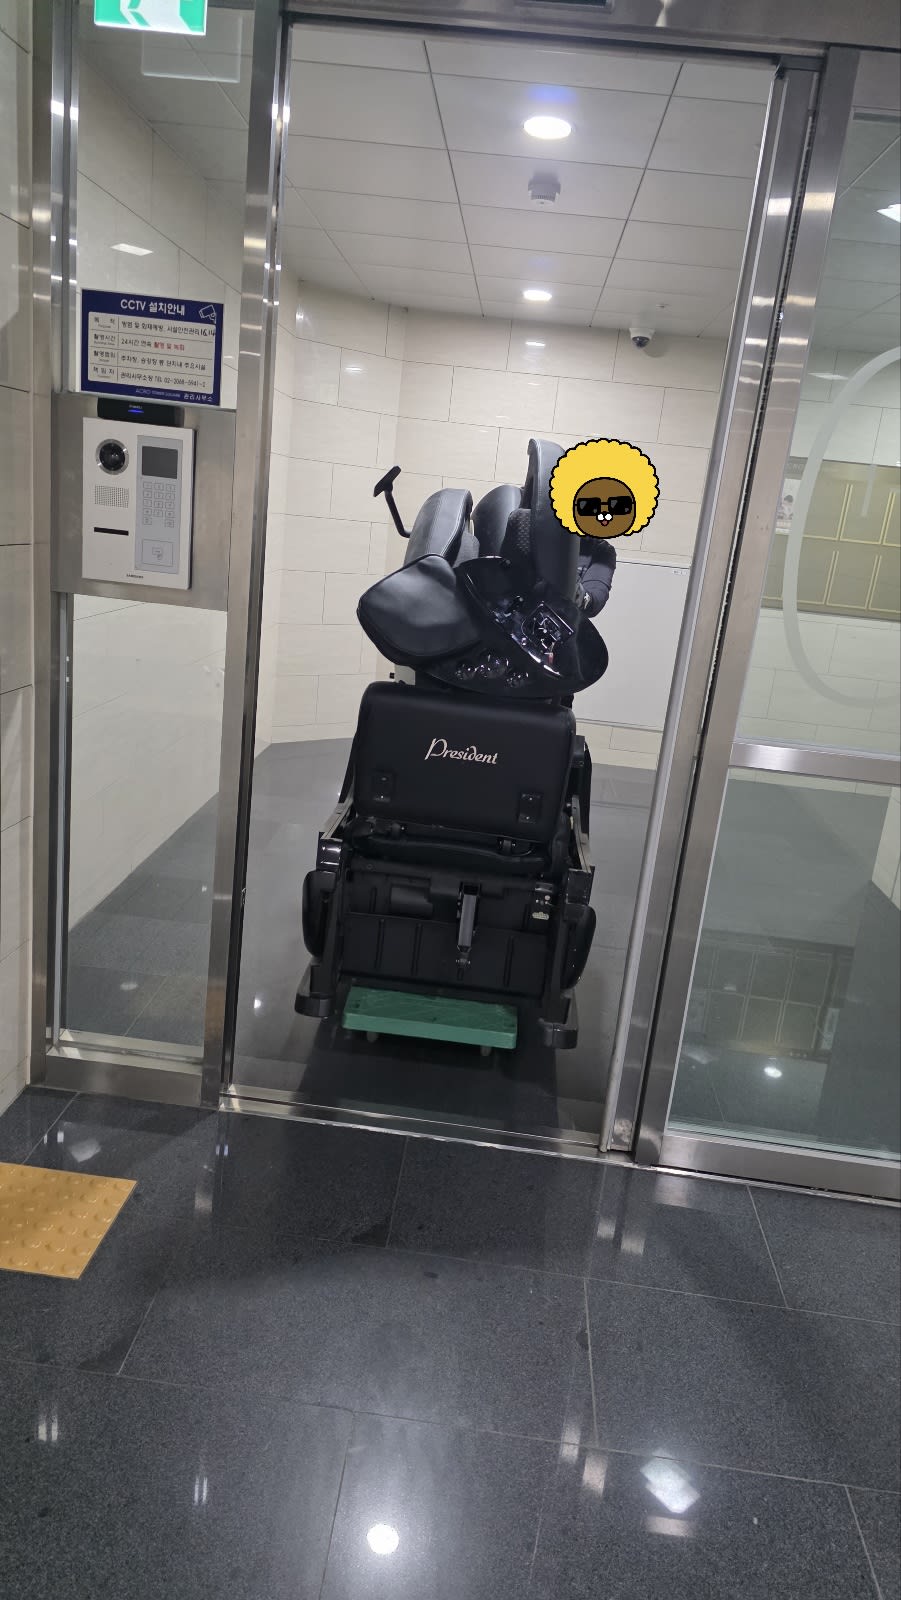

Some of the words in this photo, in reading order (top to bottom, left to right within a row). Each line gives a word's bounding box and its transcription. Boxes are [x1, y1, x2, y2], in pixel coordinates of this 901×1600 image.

[120, 299, 146, 311] CCTV
[148, 301, 185, 316] 설치안내
[121, 338, 139, 347] 24시간
[424, 737, 499, 766] President
